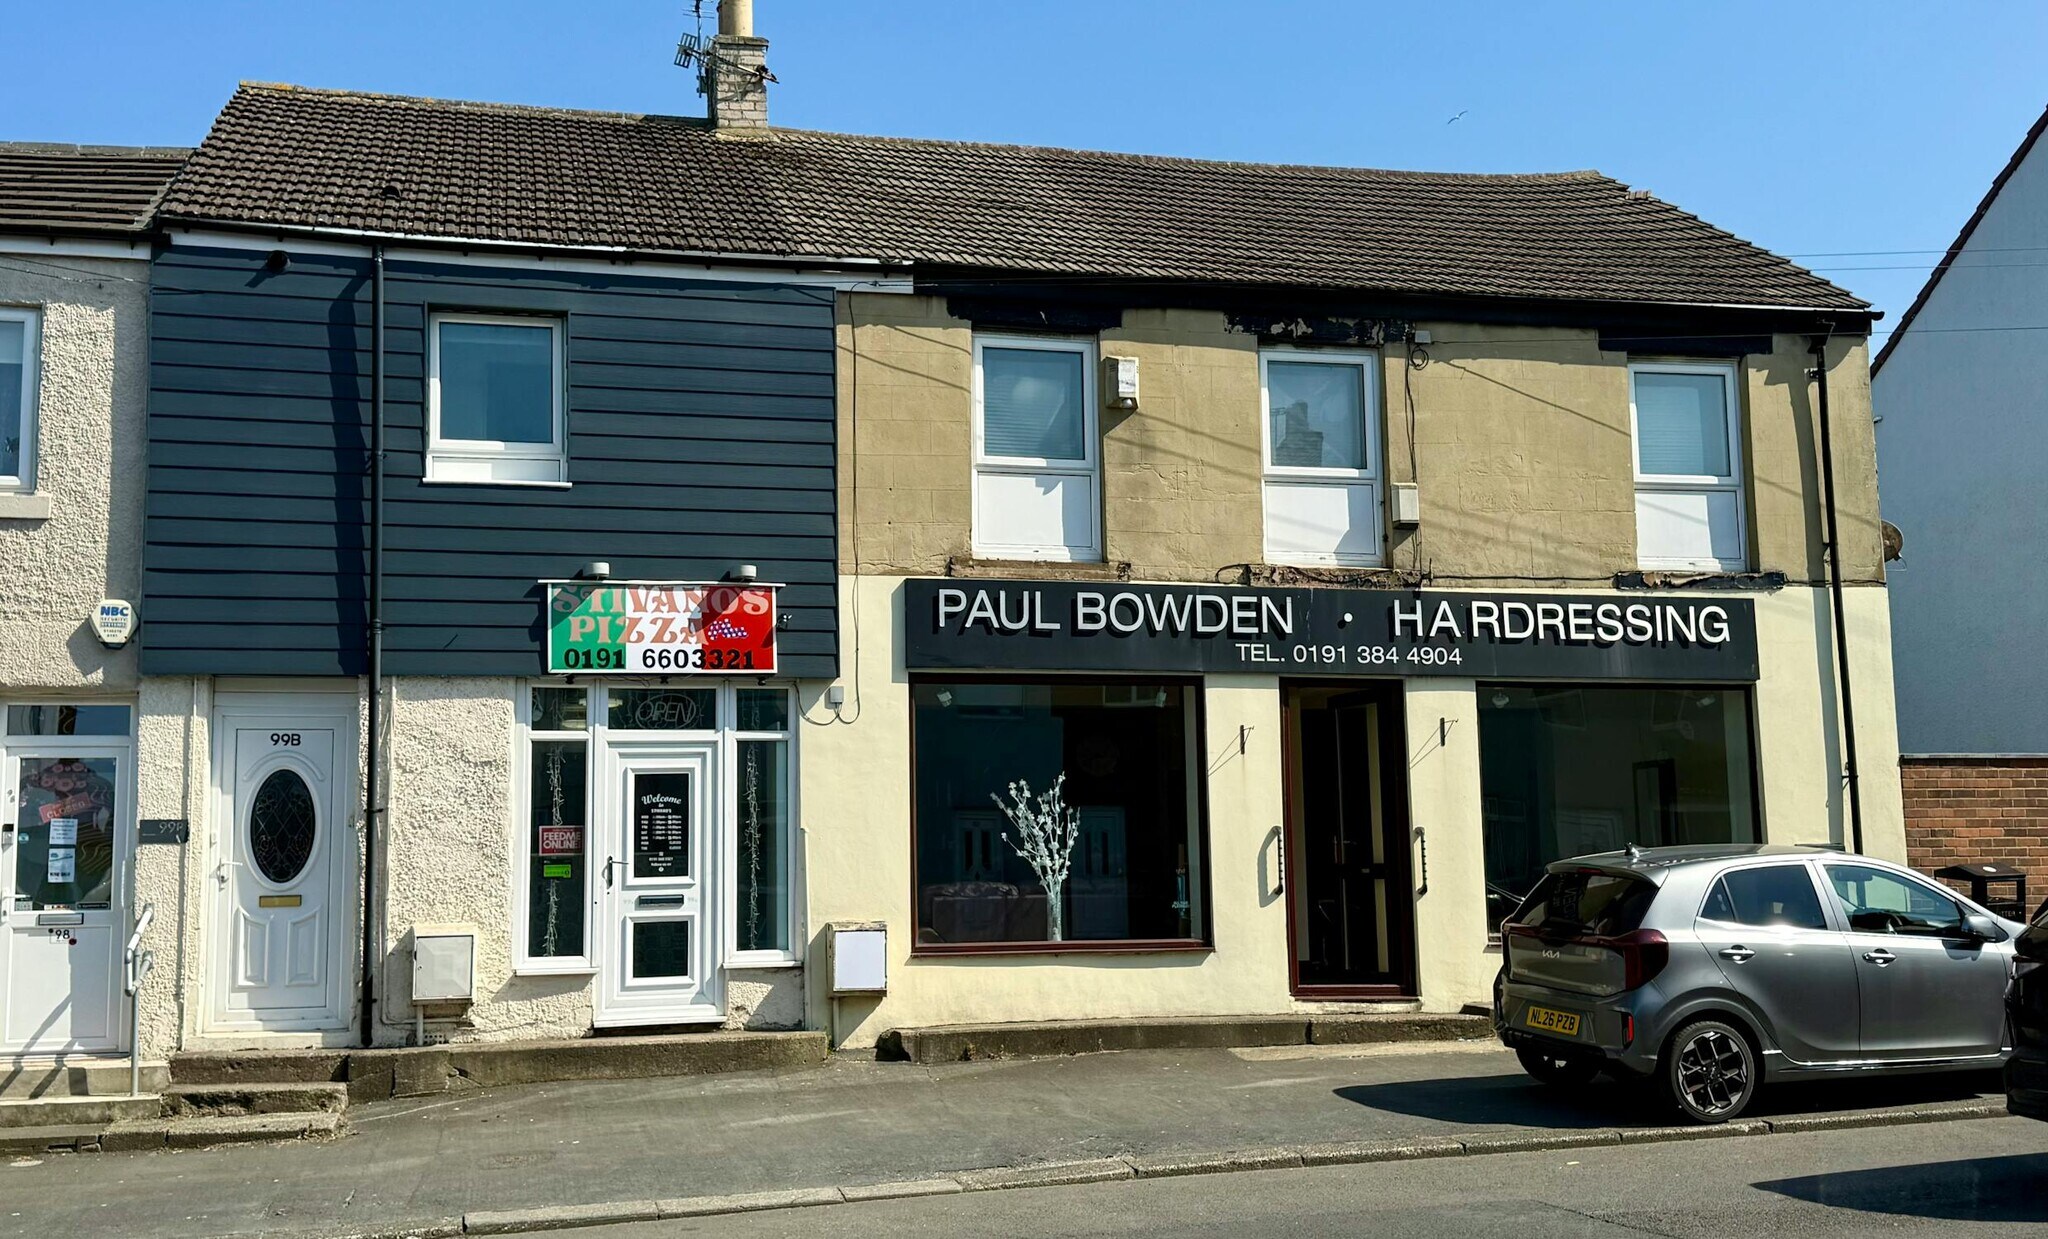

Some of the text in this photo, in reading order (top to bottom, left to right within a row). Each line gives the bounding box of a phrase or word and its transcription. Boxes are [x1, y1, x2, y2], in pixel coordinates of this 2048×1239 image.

[100, 606, 129, 617] NBC
[938, 588, 1061, 629] PAUL
[1077, 591, 1293, 634] BOWDEN
[568, 616, 709, 645] PIZZA
[564, 647, 755, 669] 0191 6603321
[1235, 644, 1463, 666] TEL. 0191 384 4904
[639, 700, 693, 722] OPEN
[270, 733, 302, 746] 99B
[641, 793, 682, 805] Welcome
[46, 800, 87, 819] CLOSED
[55, 929, 71, 940] 98
[1542, 950, 1561, 959] KIA
[1530, 1008, 1576, 1031] NL26 PZB
